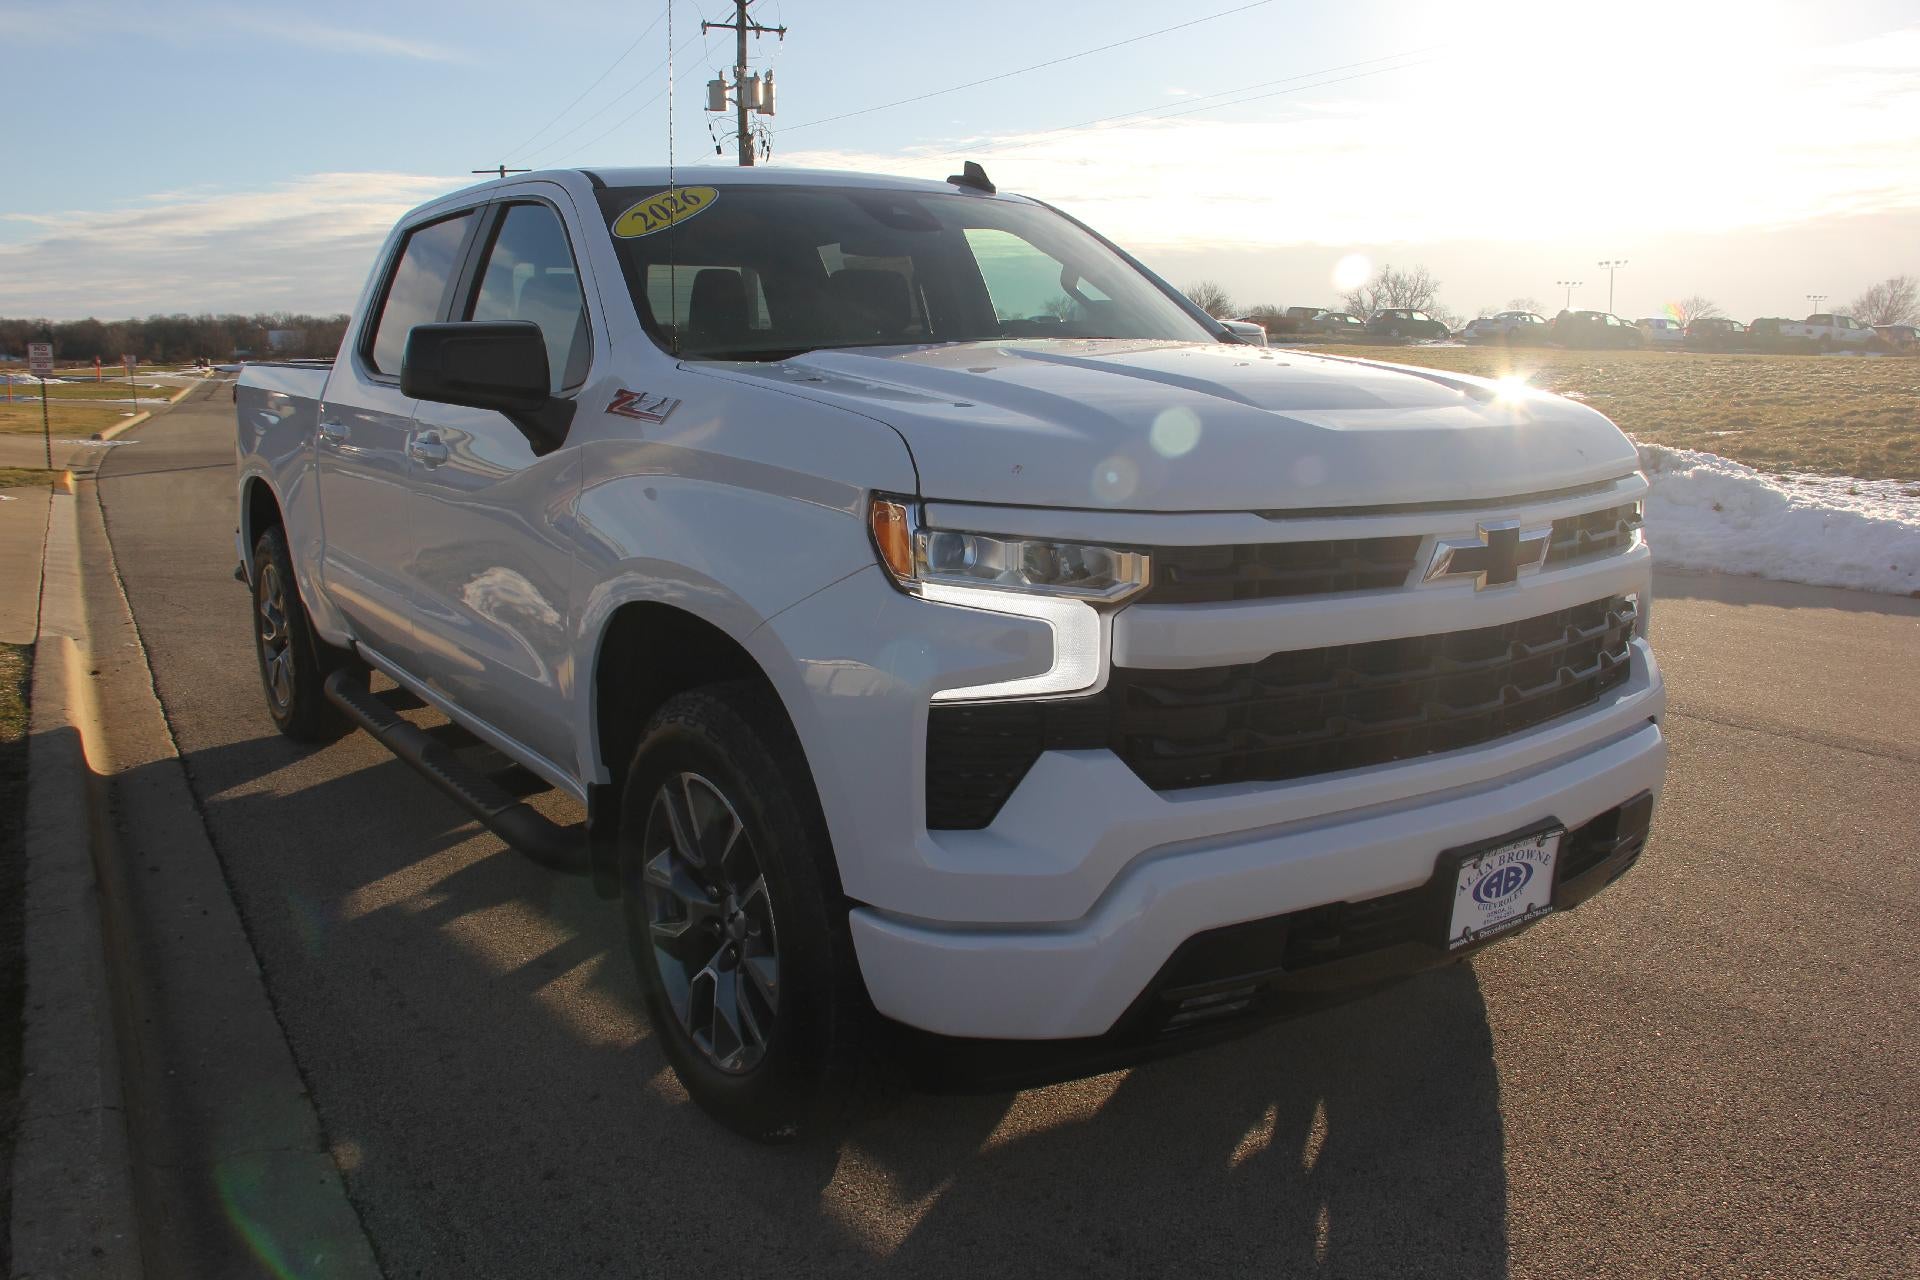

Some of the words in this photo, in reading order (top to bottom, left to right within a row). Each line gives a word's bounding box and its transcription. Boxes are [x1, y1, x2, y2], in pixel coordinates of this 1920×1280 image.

[631, 190, 701, 231] 2026
[604, 388, 682, 425] Z71
[1458, 861, 1493, 896] ALAN
[1498, 849, 1551, 866] BROWNE
[1477, 888, 1524, 911] CHEVROLET
